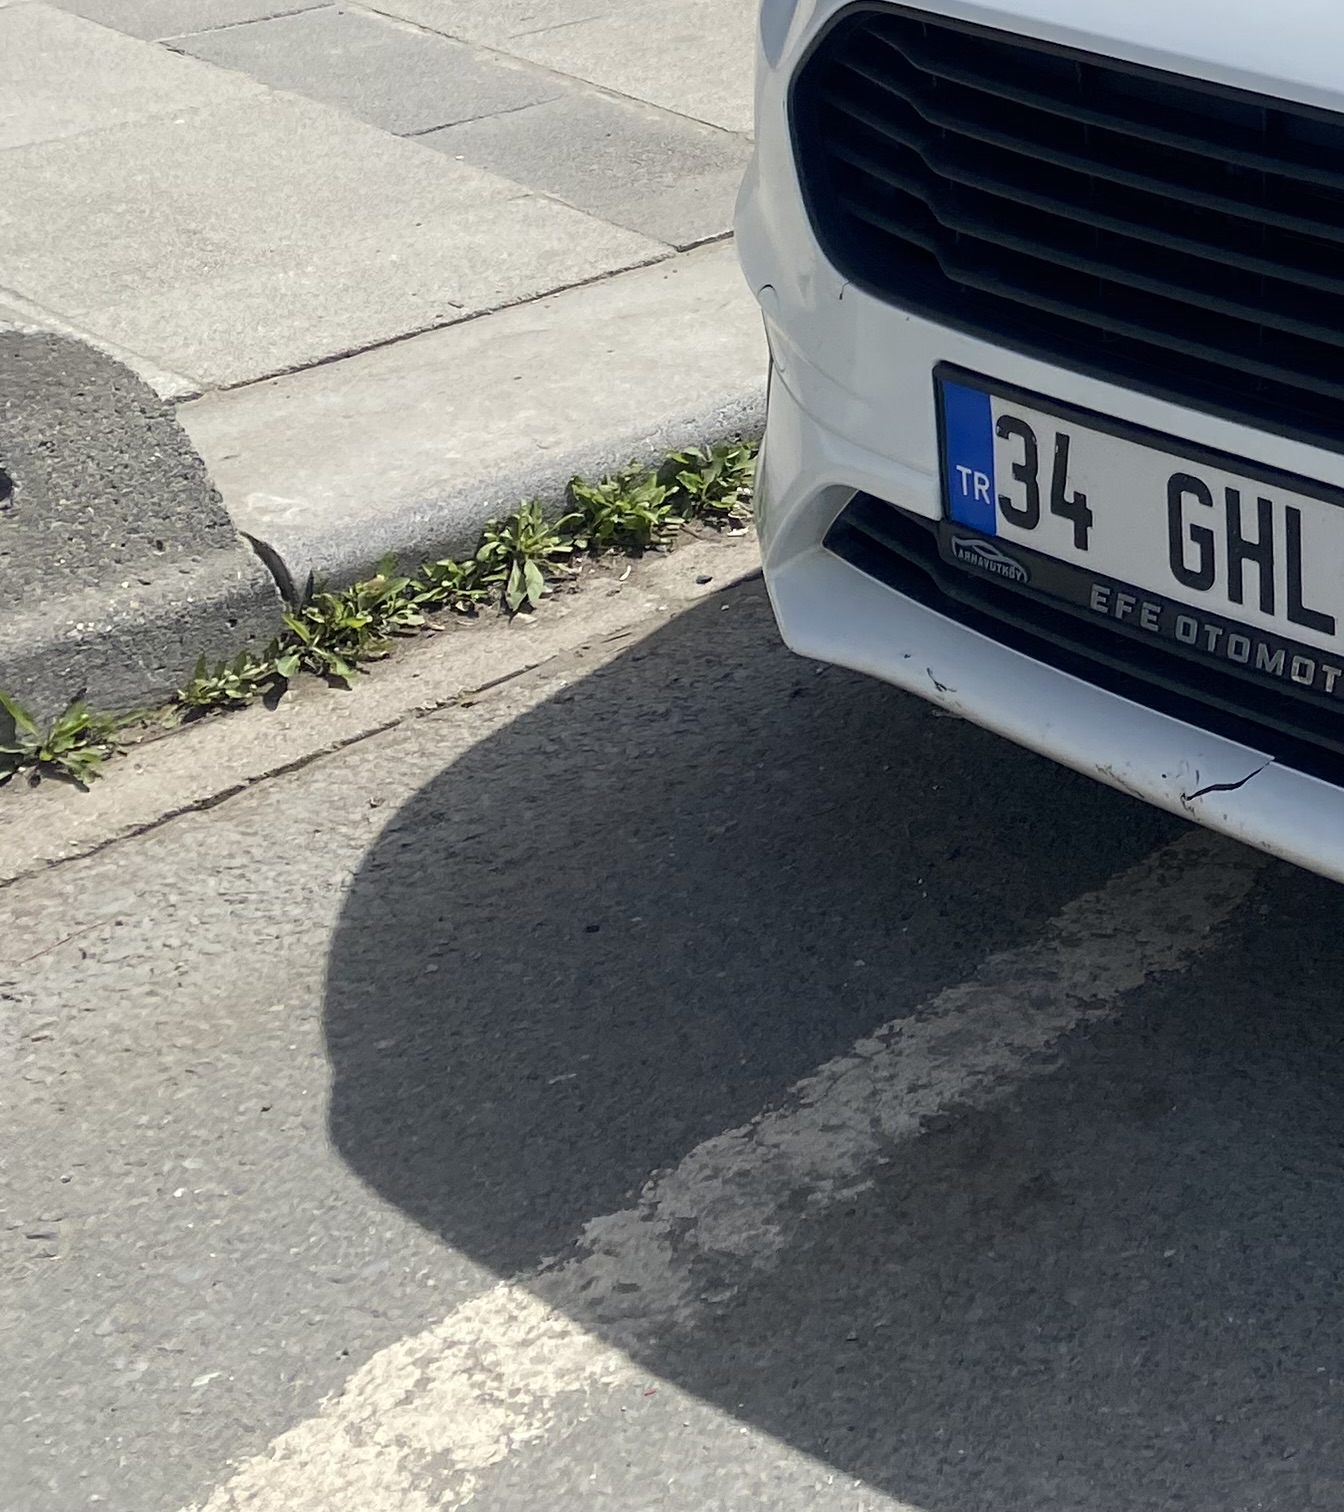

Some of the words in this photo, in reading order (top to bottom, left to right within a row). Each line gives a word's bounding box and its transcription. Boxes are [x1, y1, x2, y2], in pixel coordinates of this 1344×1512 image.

[956, 464, 991, 505] TR
[996, 414, 1093, 551] 34
[1167, 472, 1336, 636] GHL
[1090, 583, 1162, 632] EFE
